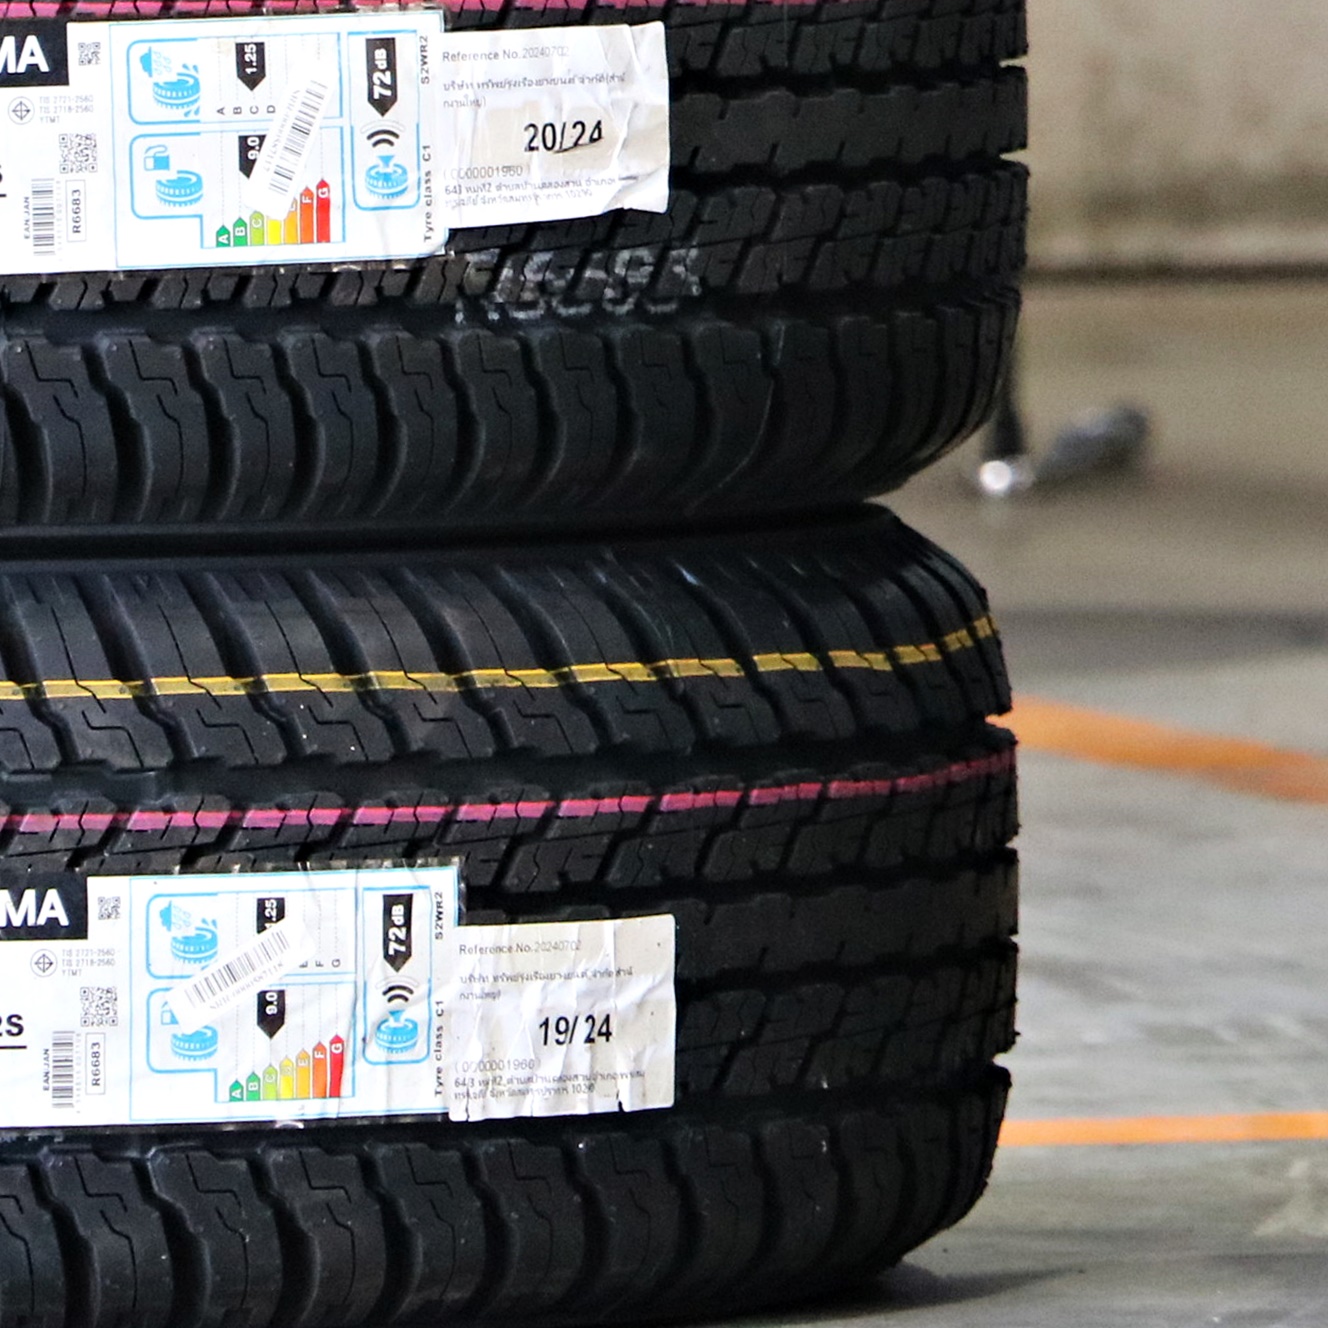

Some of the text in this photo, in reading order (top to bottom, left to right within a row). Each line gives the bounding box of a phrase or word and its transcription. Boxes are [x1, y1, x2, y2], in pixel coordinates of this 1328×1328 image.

[245, 43, 258, 74] 1.25
[419, 35, 429, 85] S2WR2
[442, 51, 499, 62] Reference
[217, 106, 226, 115] A
[233, 105, 242, 115] B
[250, 105, 259, 114] C
[266, 105, 276, 114] D
[318, 188, 329, 198] G
[422, 144, 433, 241] Tyre class C1
[302, 195, 312, 204] F
[71, 189, 81, 234] R6683
[235, 226, 245, 236] B
[218, 234, 229, 244] A
[434, 891, 444, 941] S2WR2
[459, 943, 513, 955] Reference
[316, 960, 324, 968] F
[332, 959, 341, 968] G
[265, 991, 278, 1015] 9.0
[0, 1013, 24, 1037] S
[331, 1043, 342, 1053] G
[435, 1000, 444, 1097] Tyre class C1
[315, 1050, 325, 1058] F
[91, 1042, 101, 1086] R6683
[248, 1081, 258, 1091] B
[231, 1088, 241, 1098] A
